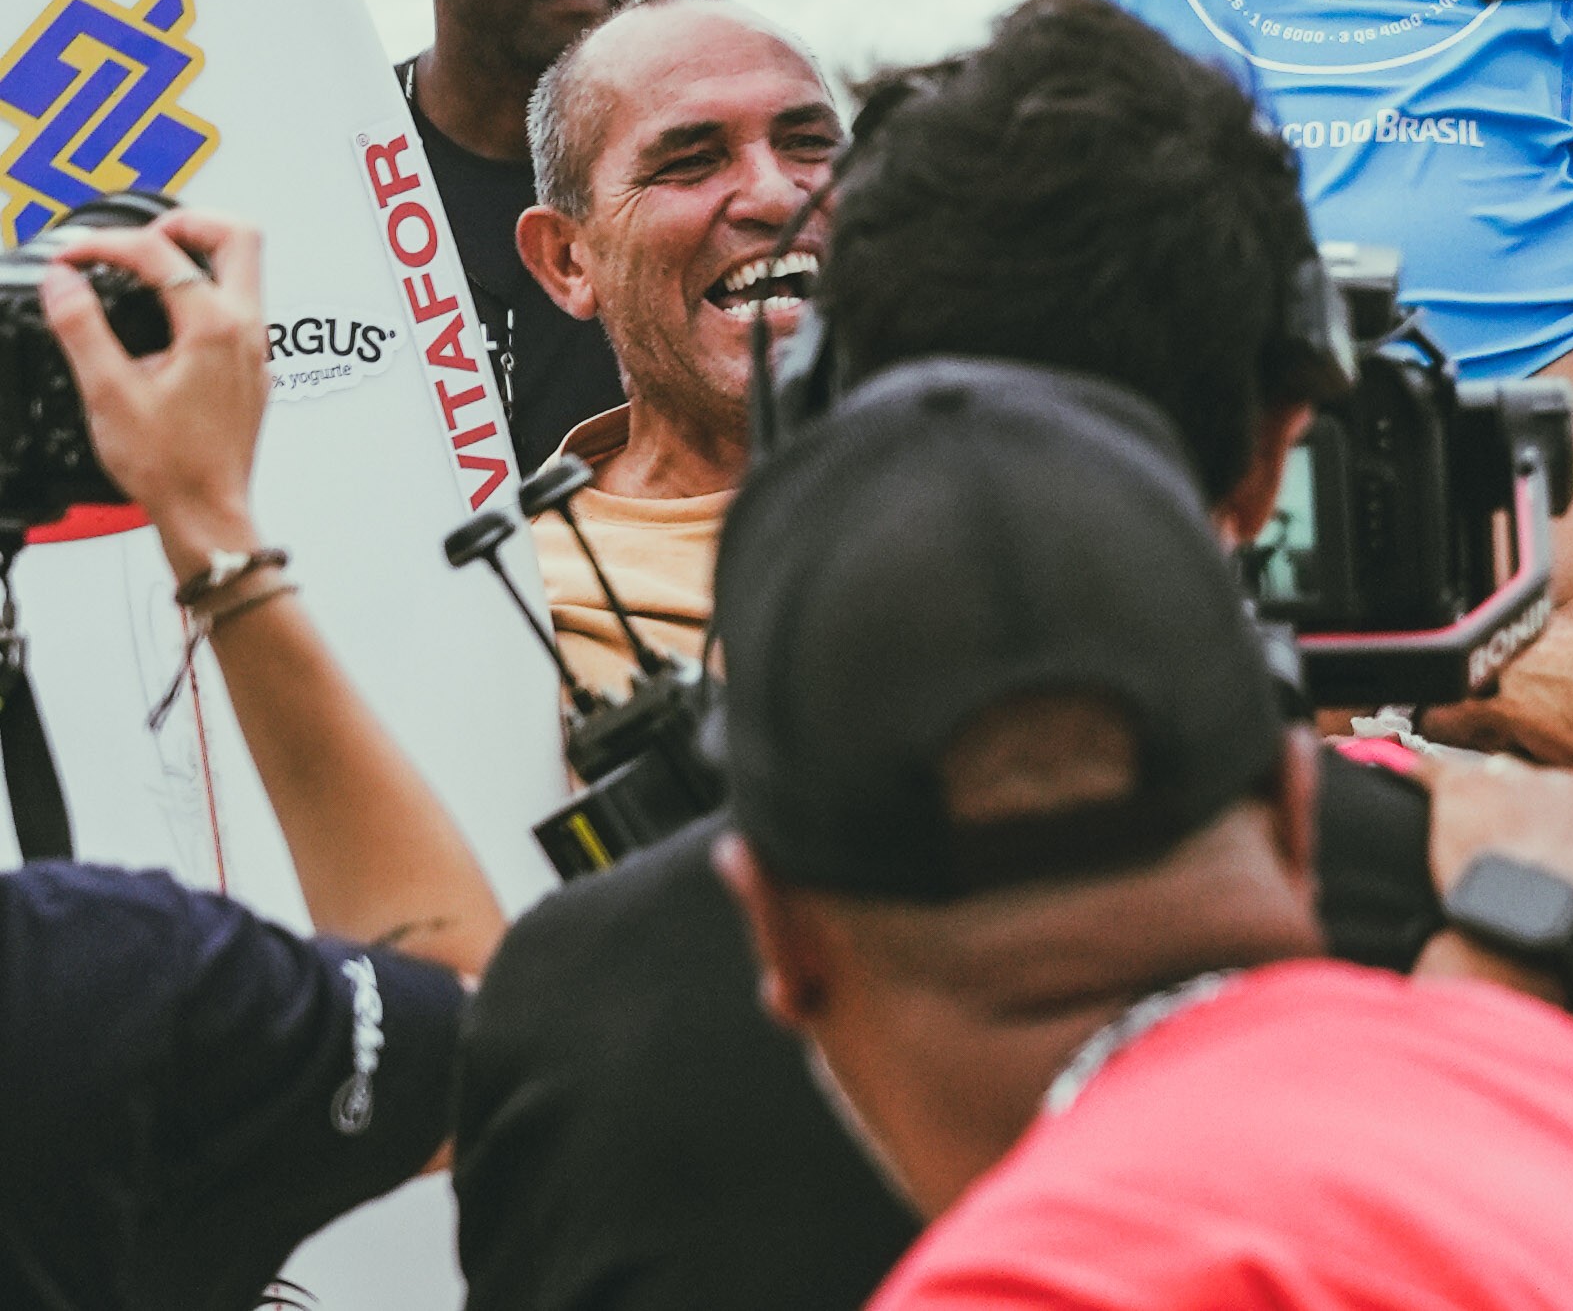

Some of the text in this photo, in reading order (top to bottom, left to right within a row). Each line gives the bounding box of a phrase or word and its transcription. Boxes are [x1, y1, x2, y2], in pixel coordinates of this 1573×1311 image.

[1260, 21, 1280, 38] QS
[1338, 30, 1349, 44] 3
[1353, 28, 1377, 45] QS
[1281, 120, 1325, 149] CO
[1374, 107, 1487, 148] BRASIL
[363, 132, 513, 512] VITAFOR
